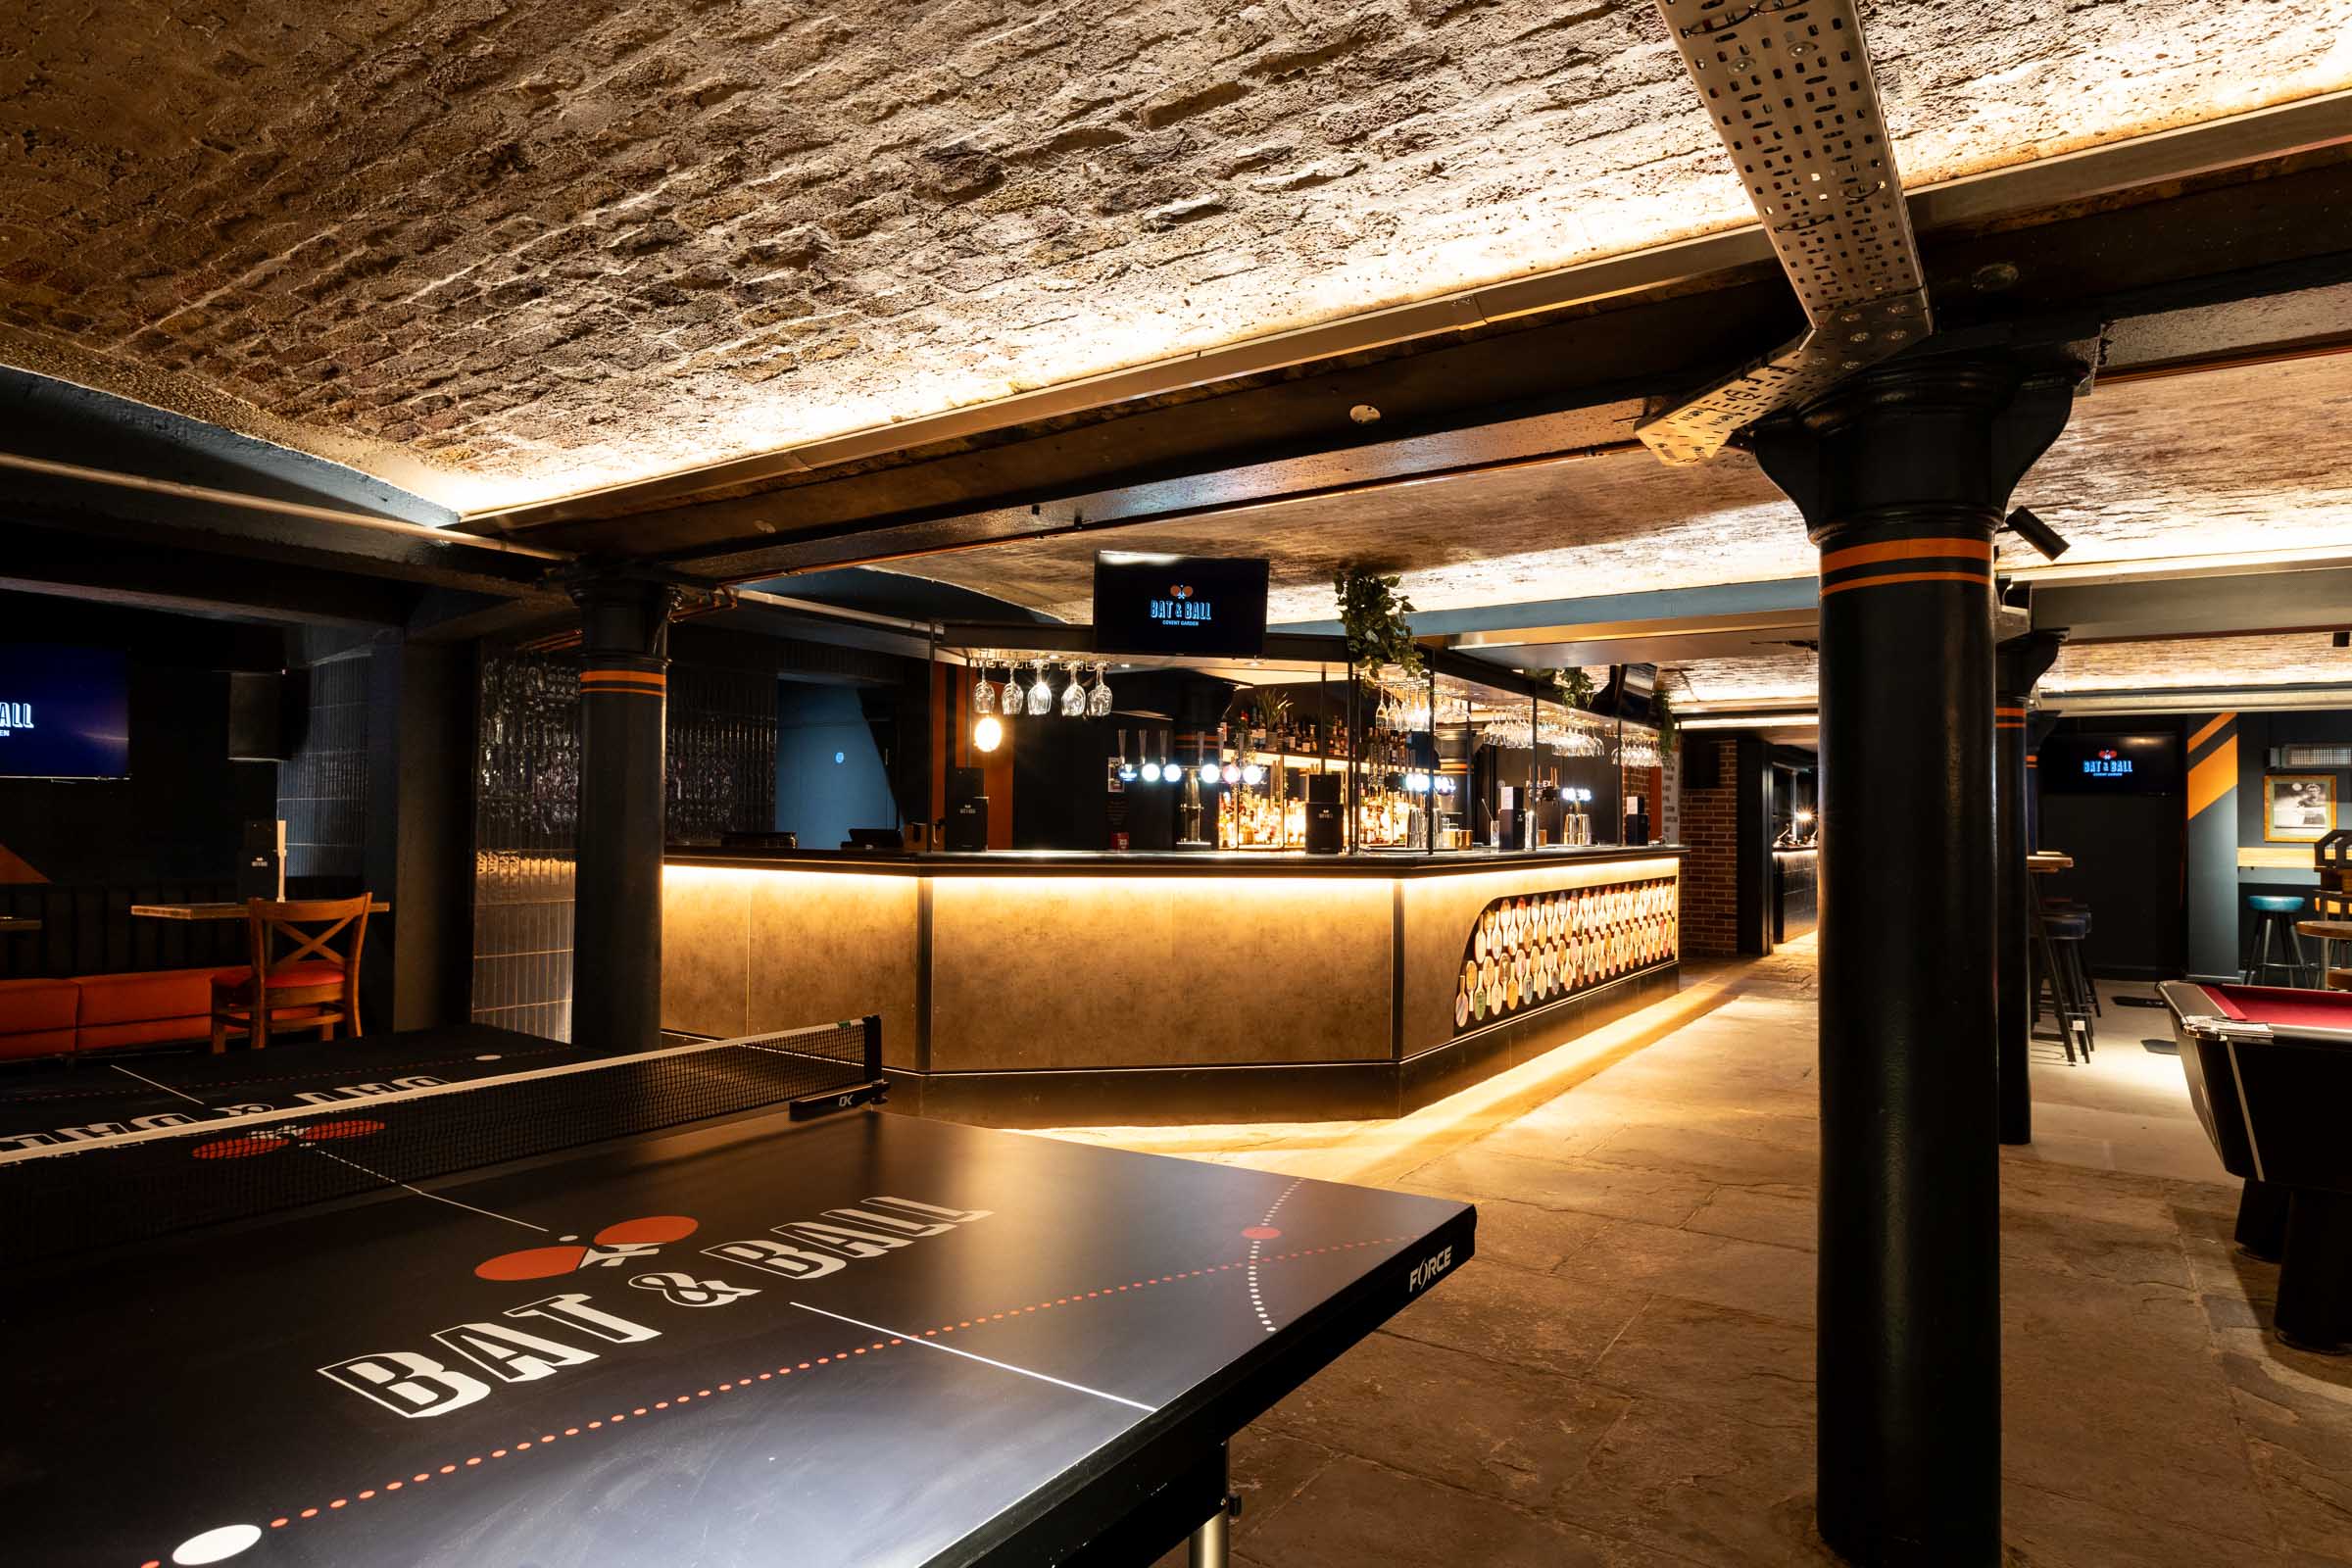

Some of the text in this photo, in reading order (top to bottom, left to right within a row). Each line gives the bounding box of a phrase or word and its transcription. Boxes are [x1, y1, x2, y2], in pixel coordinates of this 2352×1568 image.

[1151, 600, 1211, 619] BAT & BALL
[2083, 760, 2101, 772] BAT
[2110, 760, 2132, 772] BALL
[1409, 1245, 1452, 1293] FORCE
[317, 1196, 996, 1419] BAT & BALL
